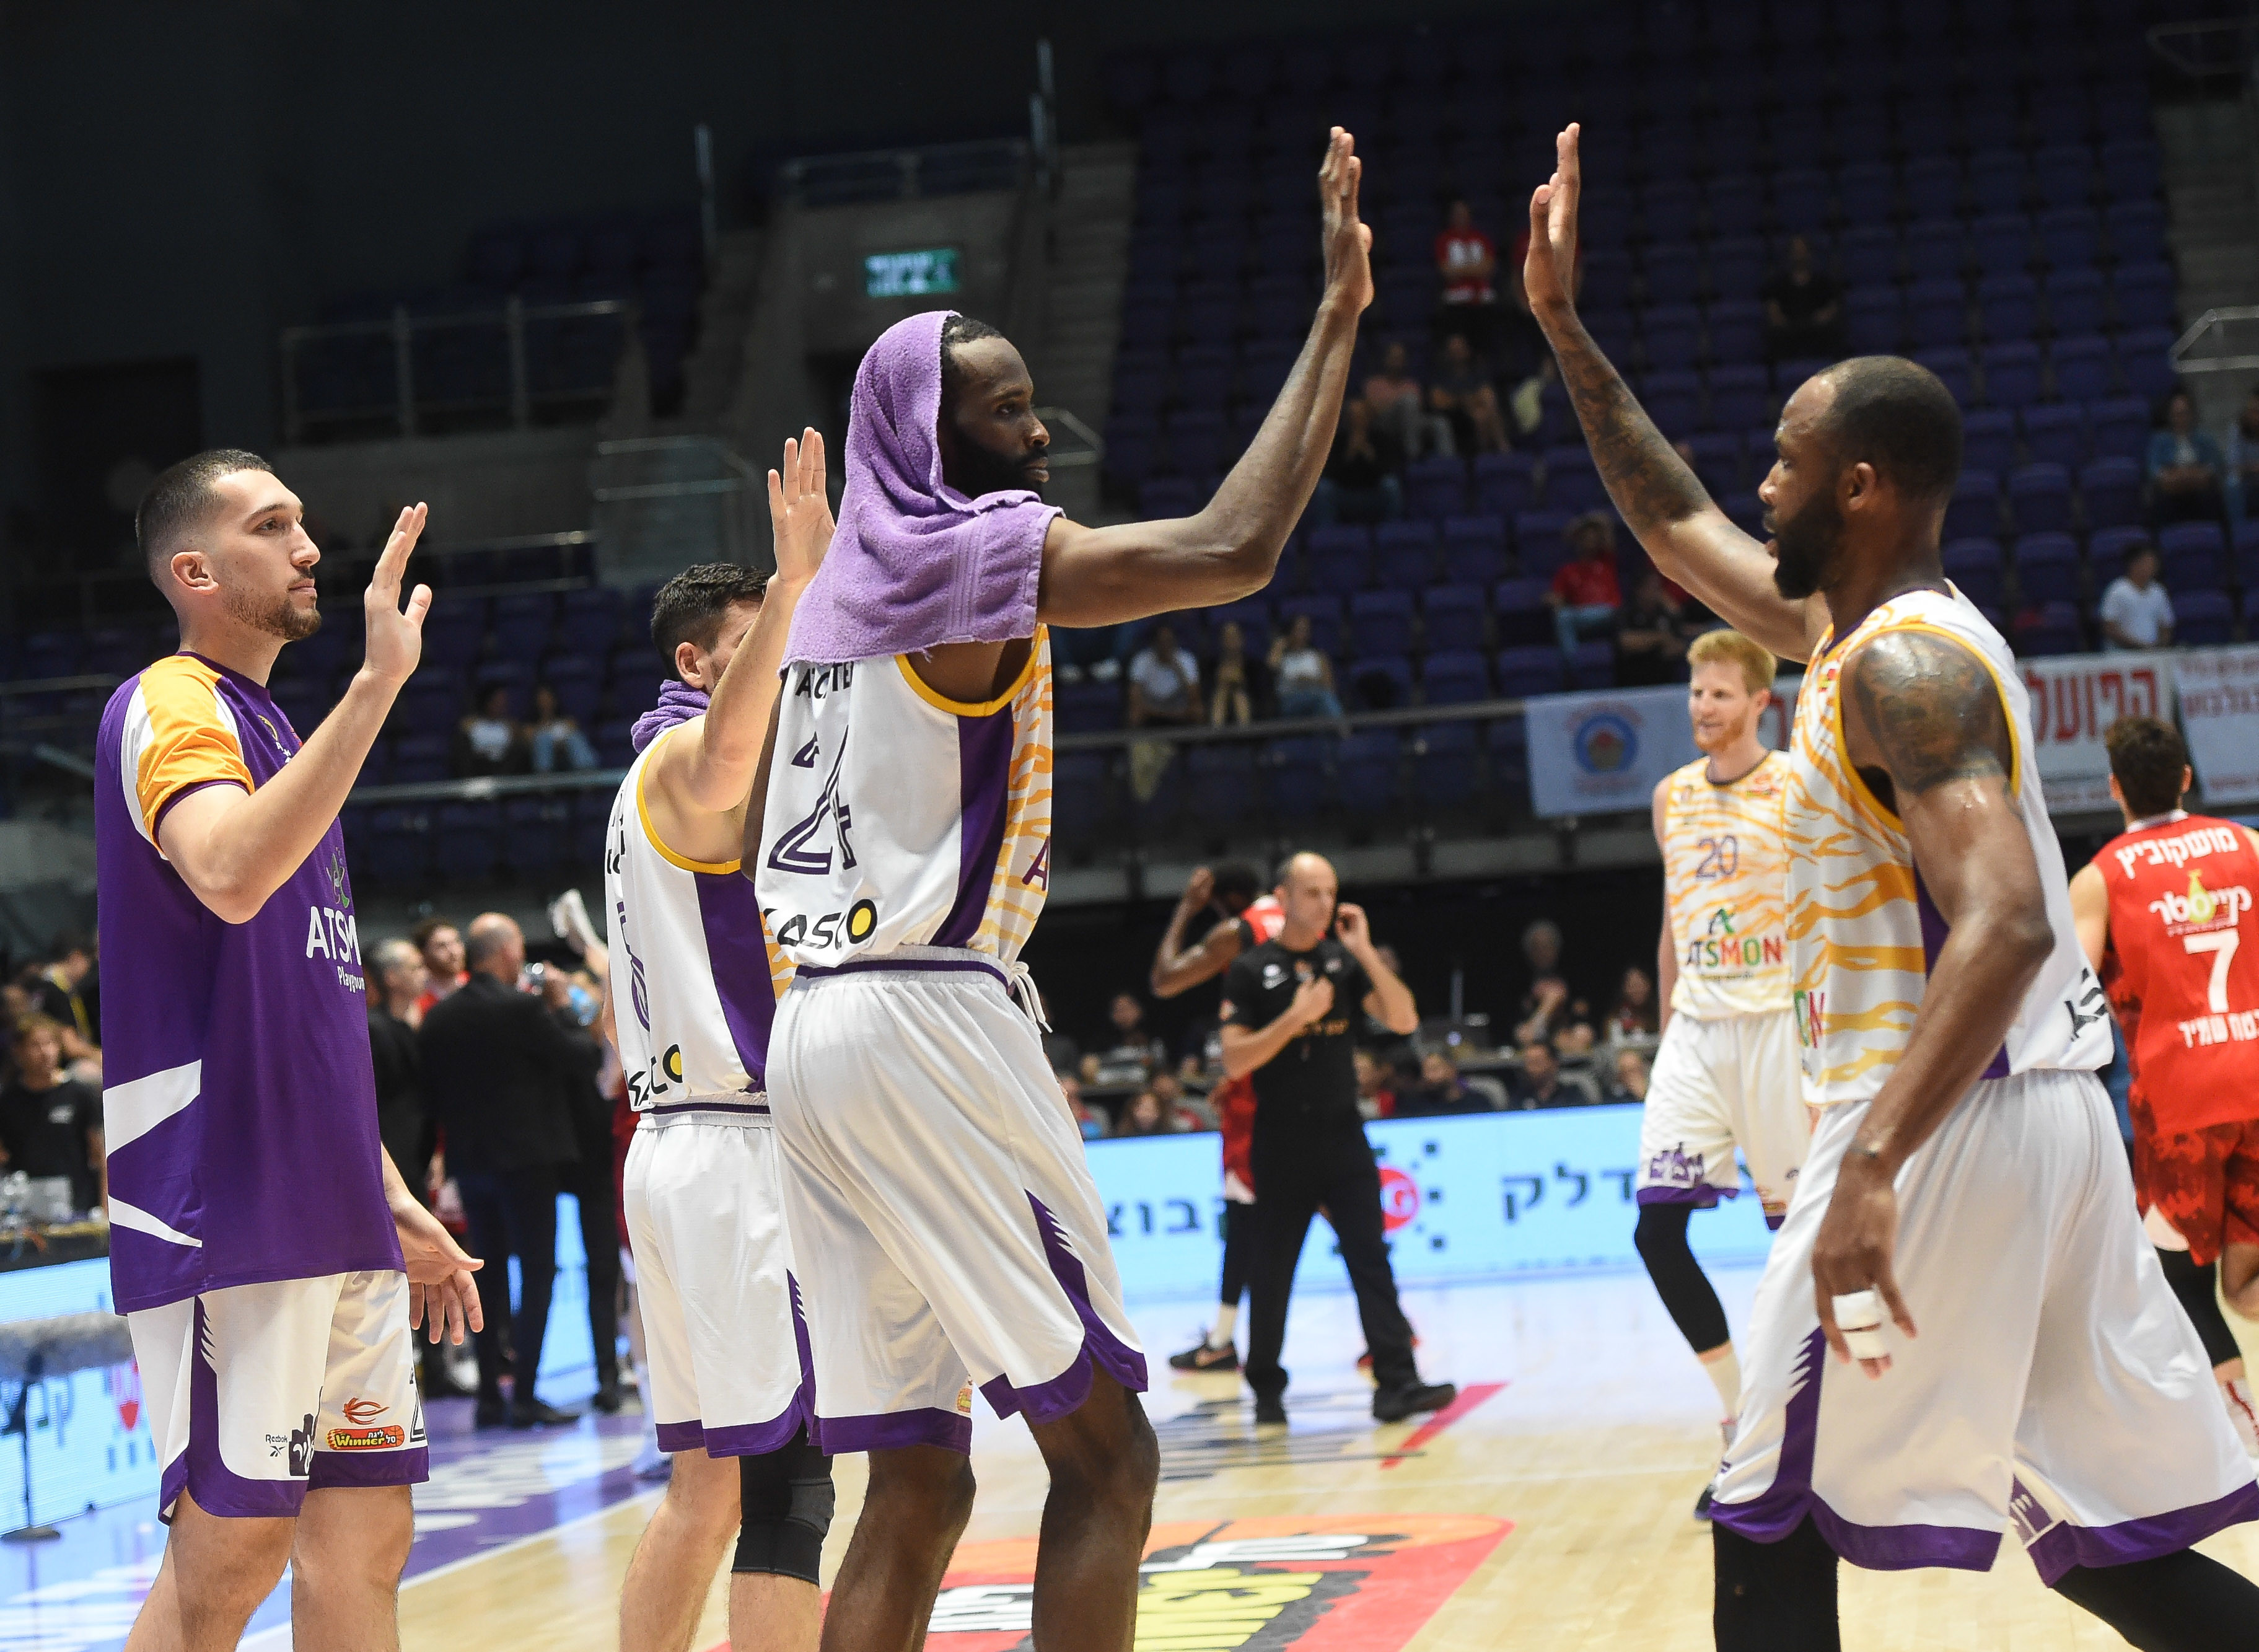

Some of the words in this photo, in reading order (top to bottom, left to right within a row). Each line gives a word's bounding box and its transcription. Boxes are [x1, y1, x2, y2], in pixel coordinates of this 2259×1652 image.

[1696, 834, 1739, 880] 20
[2115, 827, 2239, 880] מושקוביץ
[2183, 928, 2240, 1013] 7
[1502, 1164, 1638, 1221] דלק
[367, 1429, 384, 1438] ליגת
[385, 1435, 396, 1444] סל
